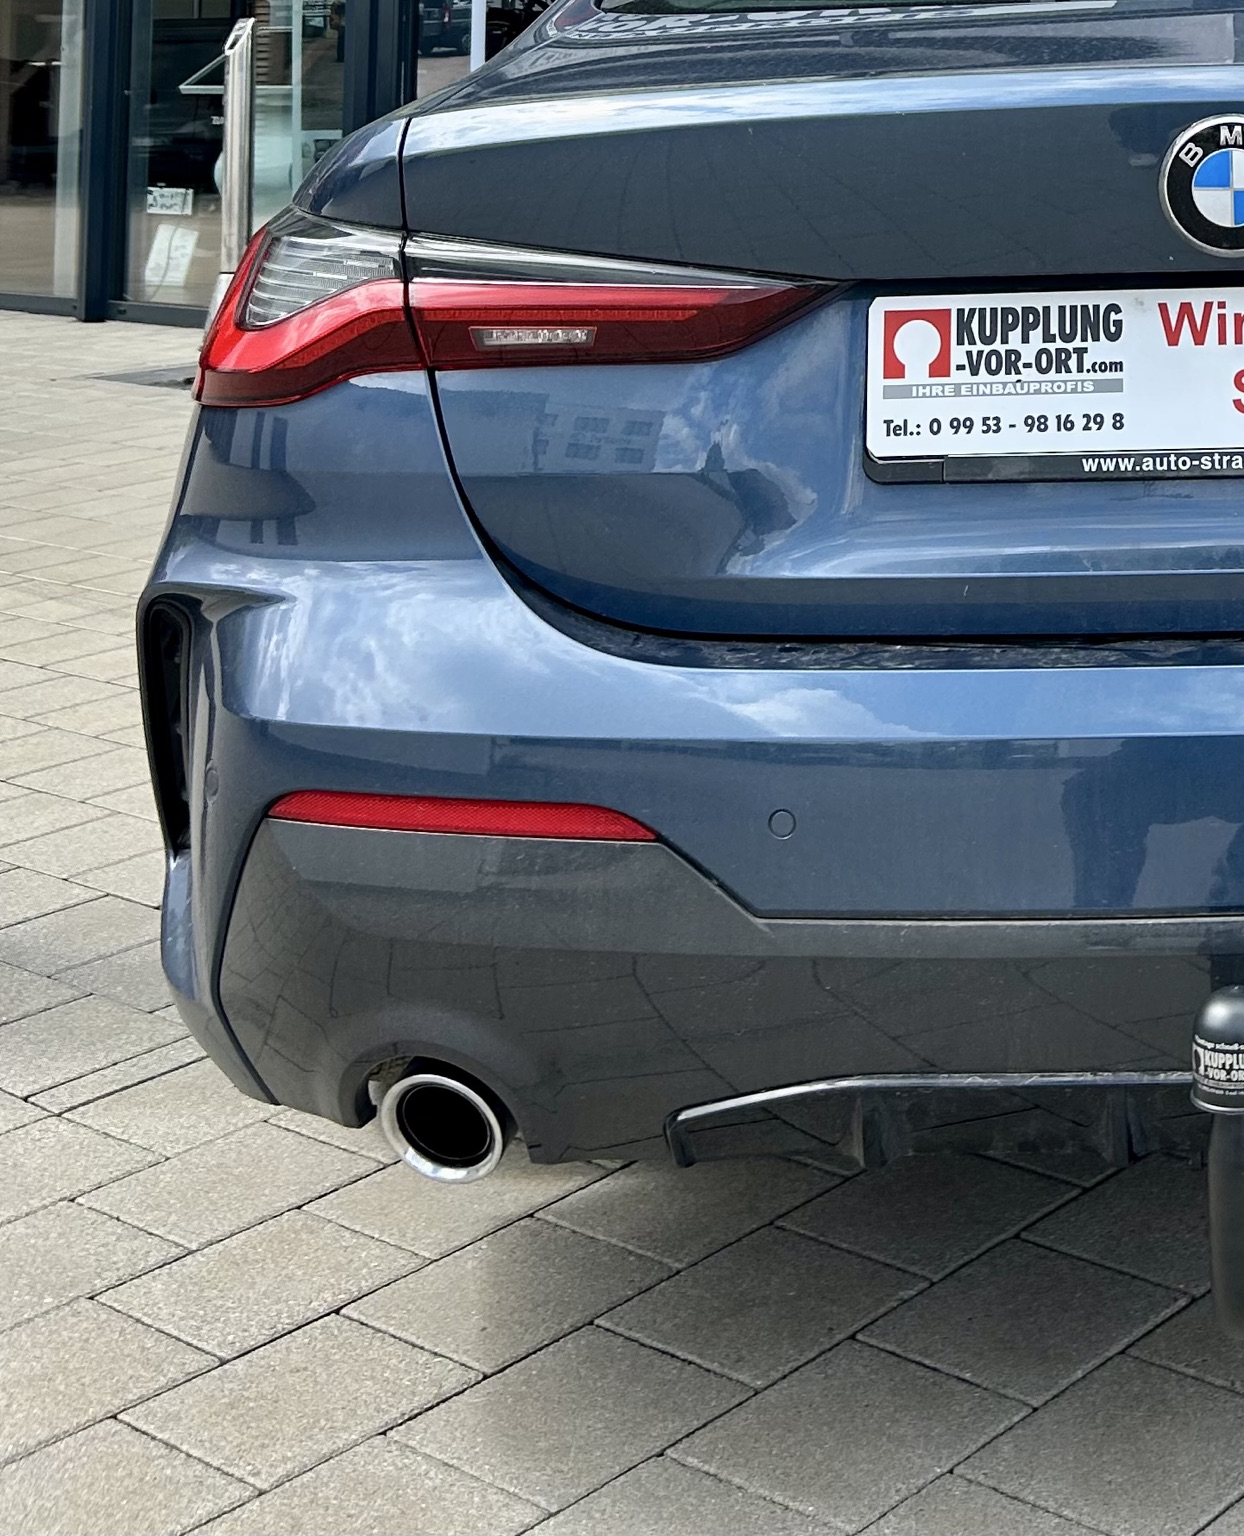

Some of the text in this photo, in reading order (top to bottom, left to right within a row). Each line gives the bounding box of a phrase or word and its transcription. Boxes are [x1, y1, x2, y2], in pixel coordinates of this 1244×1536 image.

[956, 303, 1123, 346] KUPPLUNG
[955, 347, 1124, 377] -VOR-ORT.com
[911, 381, 1095, 397] IHRE EINBAUPROFIS
[883, 418, 922, 437] Tel.:
[929, 418, 942, 436] 0
[949, 417, 974, 435] 99
[981, 416, 1002, 434] 53
[1024, 415, 1049, 433] 98
[1056, 414, 1075, 432] 16
[1082, 413, 1105, 431] 29
[1112, 413, 1124, 431] 8
